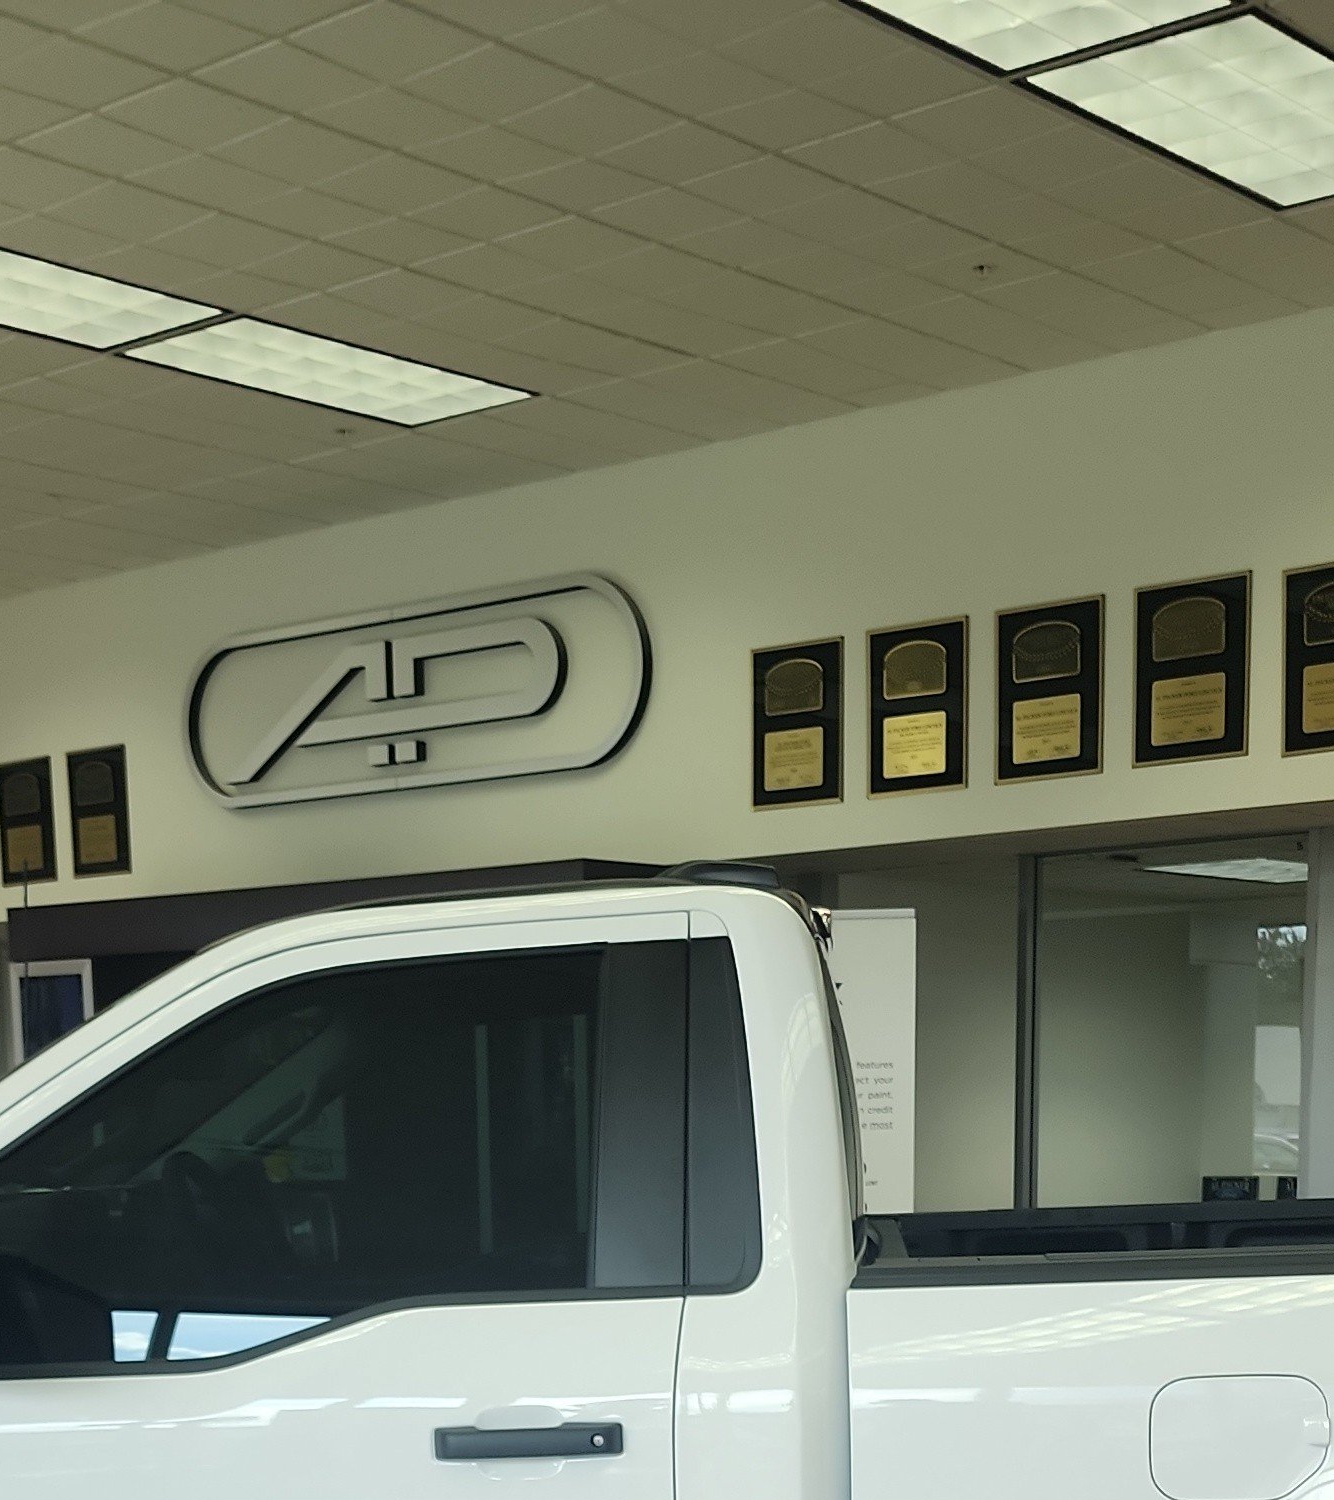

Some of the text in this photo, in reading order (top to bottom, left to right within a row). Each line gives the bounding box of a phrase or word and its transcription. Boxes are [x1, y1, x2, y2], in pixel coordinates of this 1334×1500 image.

[856, 1061, 894, 1070] features
[873, 1077, 894, 1086] your
[867, 1106, 894, 1115] credit
[869, 1121, 894, 1131] most
